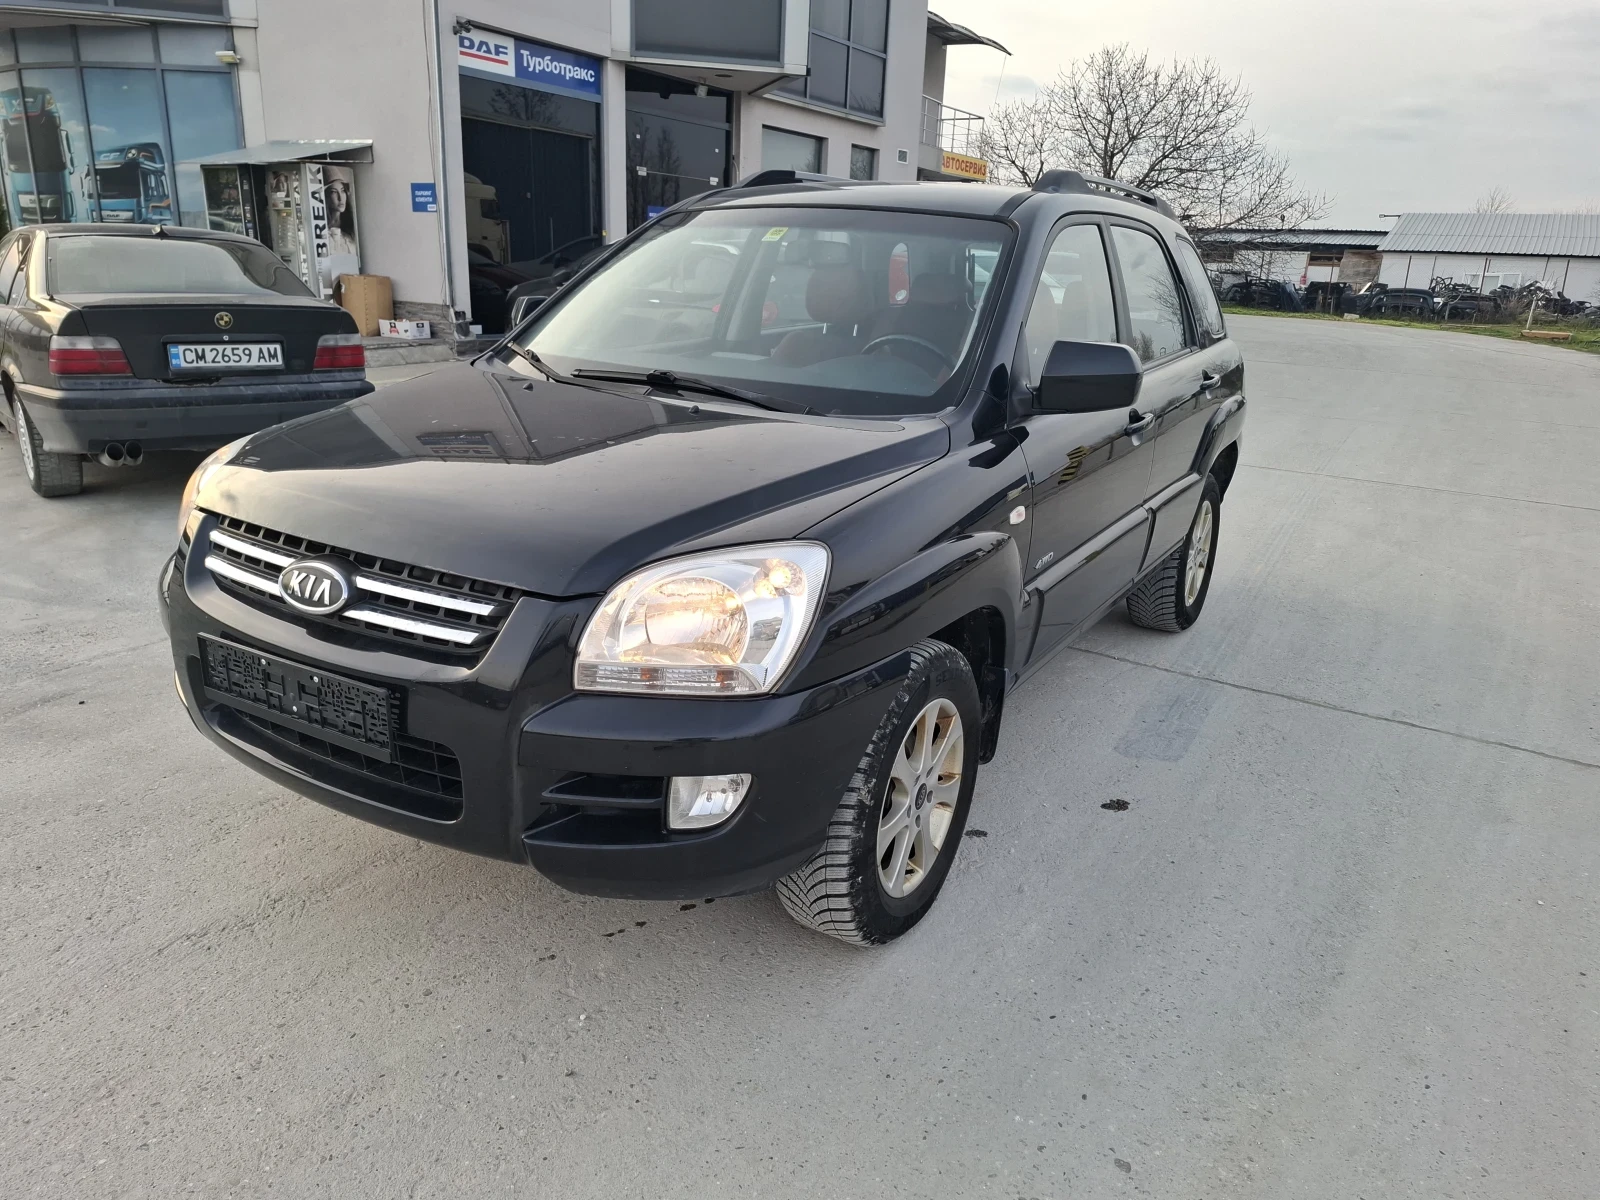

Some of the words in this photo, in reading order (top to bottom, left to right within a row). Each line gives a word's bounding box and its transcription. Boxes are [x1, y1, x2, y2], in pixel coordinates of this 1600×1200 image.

[459, 35, 508, 57] DAF
[520, 49, 596, 82] Турботракс
[100, 152, 120, 160] CF
[309, 165, 329, 258] BREAK
[182, 347, 207, 365] CM
[209, 347, 253, 364] 2659
[257, 346, 280, 363] AM
[286, 569, 332, 606] KIA
